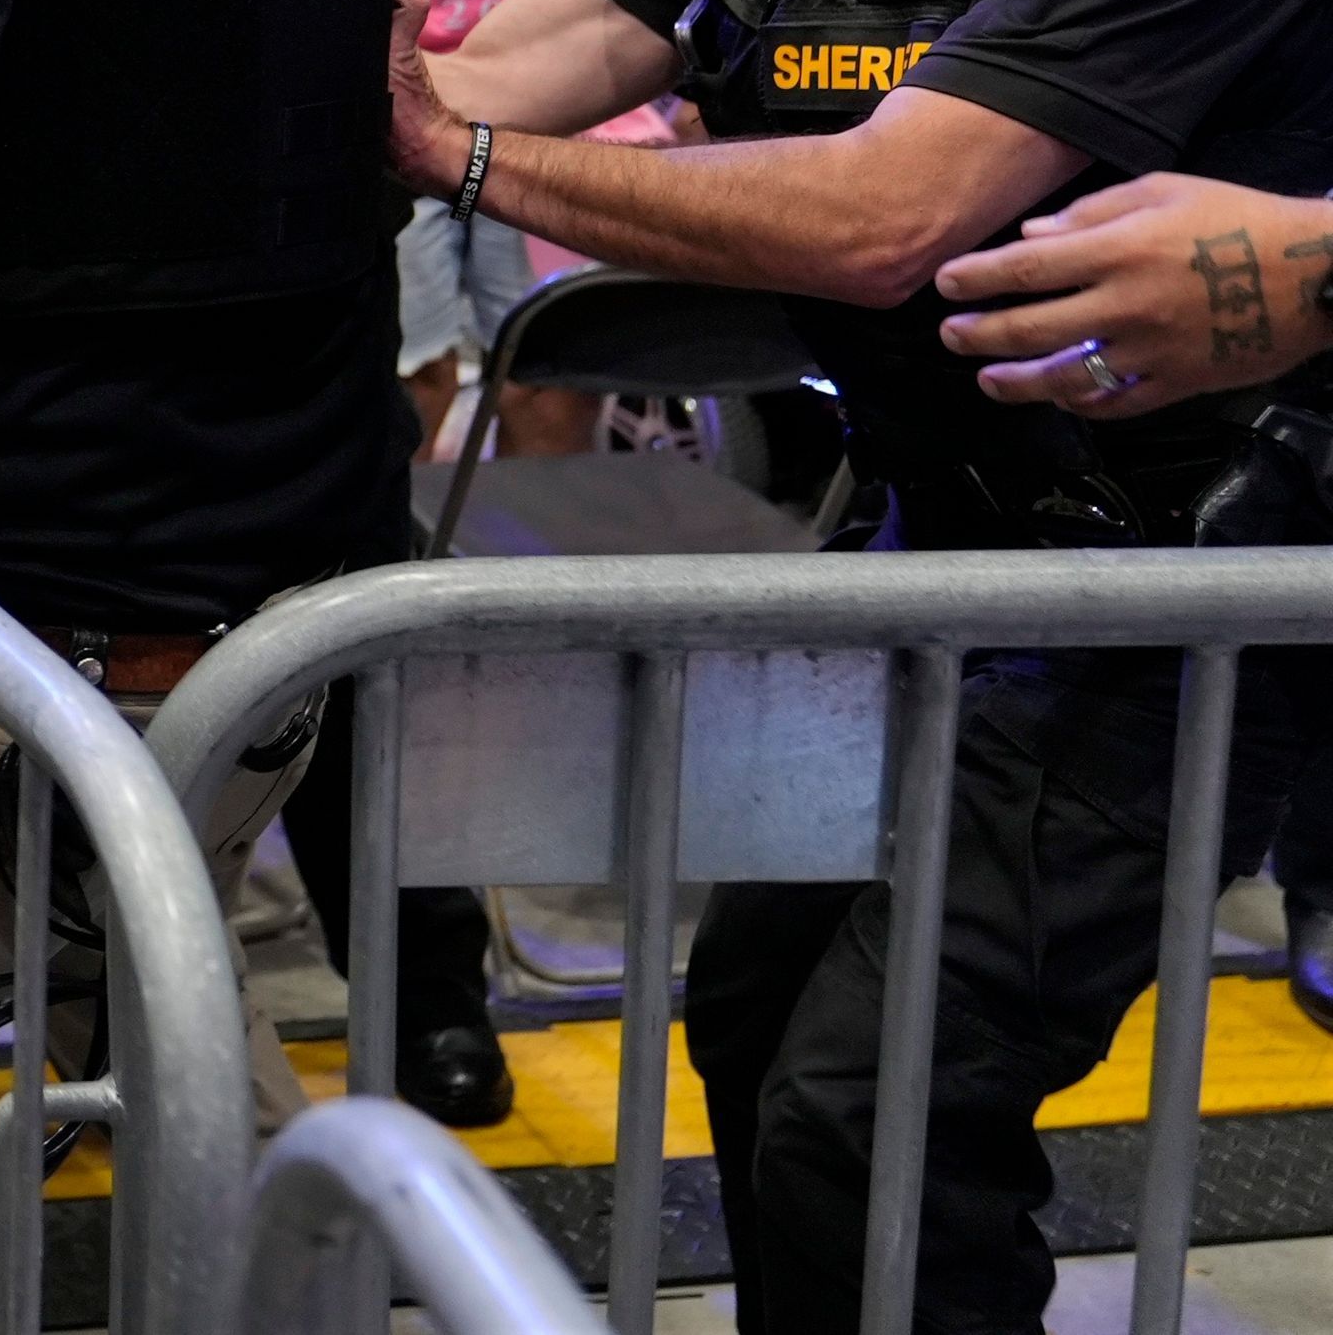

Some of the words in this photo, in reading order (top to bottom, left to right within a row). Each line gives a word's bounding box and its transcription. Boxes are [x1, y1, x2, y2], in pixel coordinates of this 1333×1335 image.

[773, 42, 932, 91] SHERIF
[459, 181, 479, 214] LIVES
[469, 127, 490, 180] MATTER
